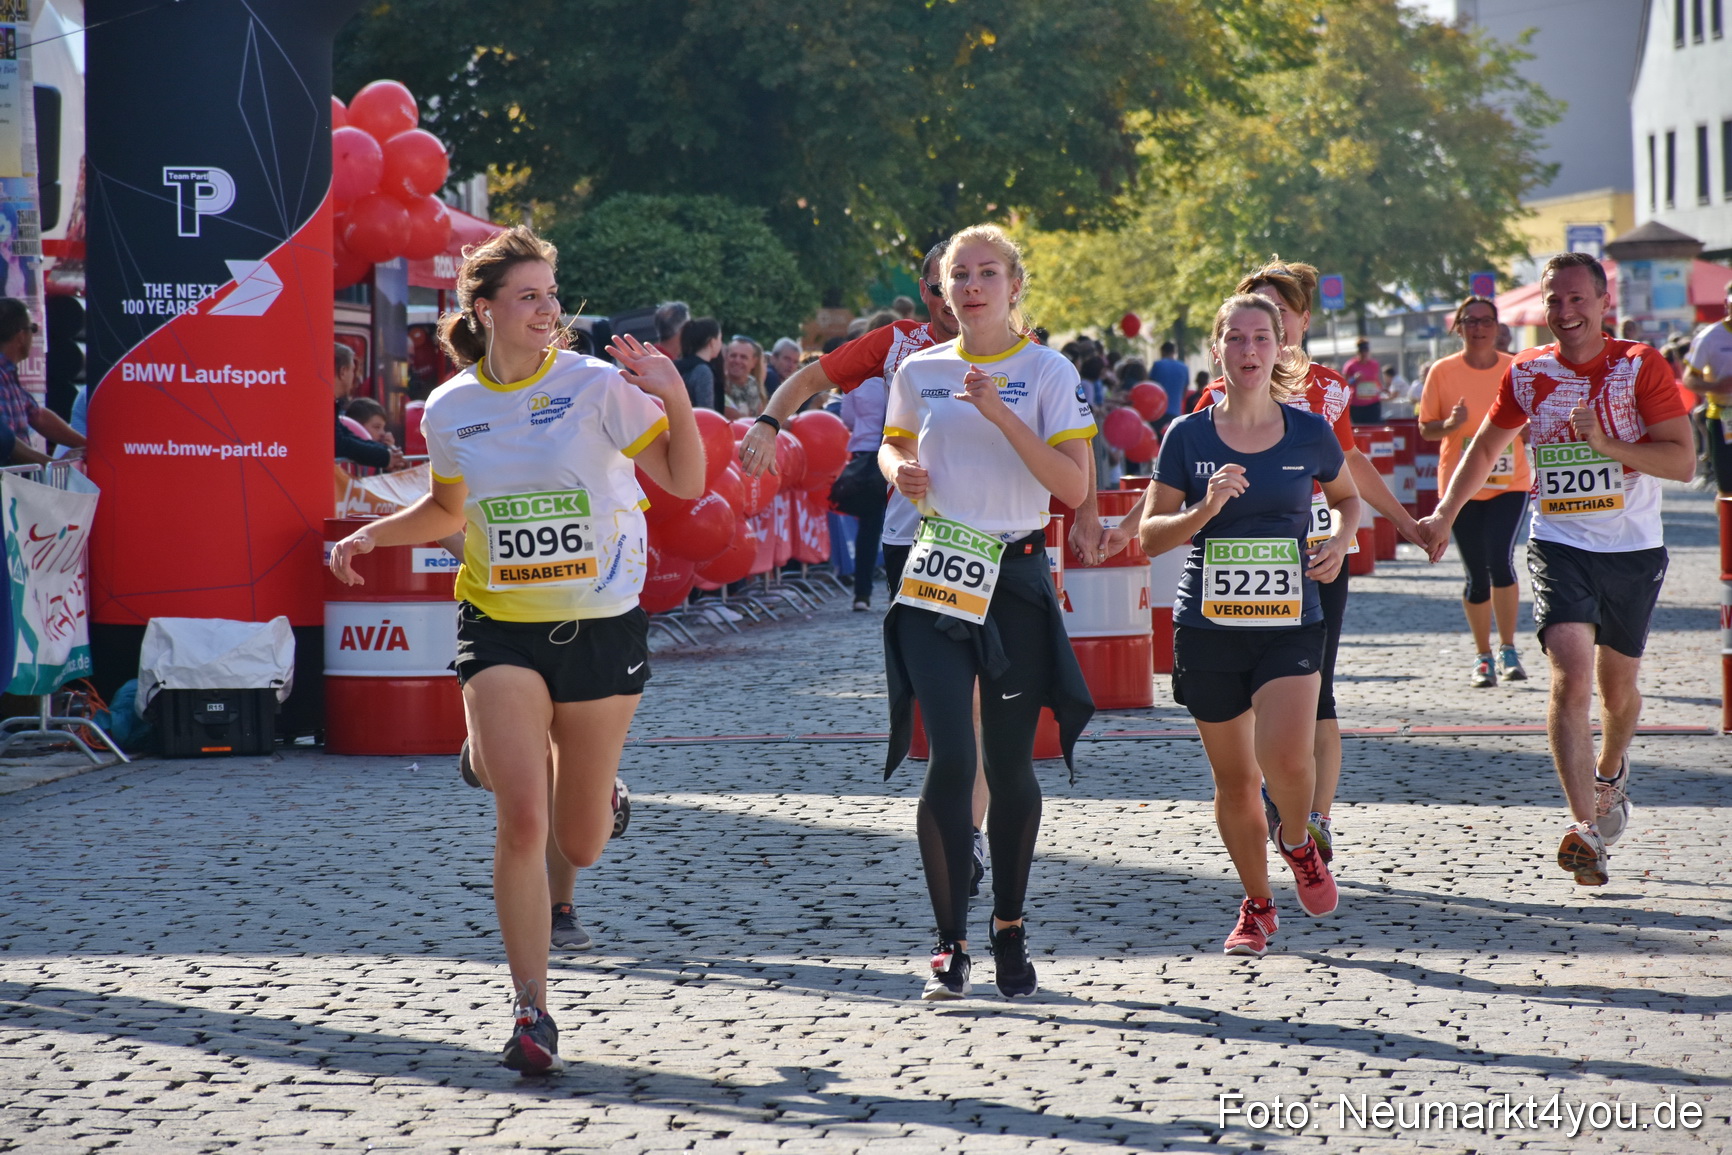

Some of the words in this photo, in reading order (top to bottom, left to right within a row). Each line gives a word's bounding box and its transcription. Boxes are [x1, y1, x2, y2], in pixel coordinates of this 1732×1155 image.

[168, 172, 189, 180] Team
[143, 283, 172, 299] THE
[176, 284, 218, 299] NEXT
[122, 299, 144, 315] 100
[147, 300, 199, 315] YEARS
[122, 363, 175, 383] BMW
[181, 364, 287, 388] Laufsport
[531, 396, 550, 411] 20
[458, 424, 489, 437] BOCK
[124, 440, 288, 460] www.bmw-partl.de
[1546, 467, 1611, 494] 5201
[489, 495, 580, 519] BOCK
[1549, 498, 1615, 512] MATTHIAS
[498, 523, 583, 559] 5096
[924, 523, 993, 558] BOCK
[1213, 543, 1292, 560] BOCK
[500, 563, 587, 582] ELISABETH
[913, 548, 985, 589] 5069
[1214, 569, 1290, 596] 5223
[918, 584, 958, 605] LINDA
[1213, 604, 1292, 616] VERONIKA
[339, 619, 410, 651] AVIA
